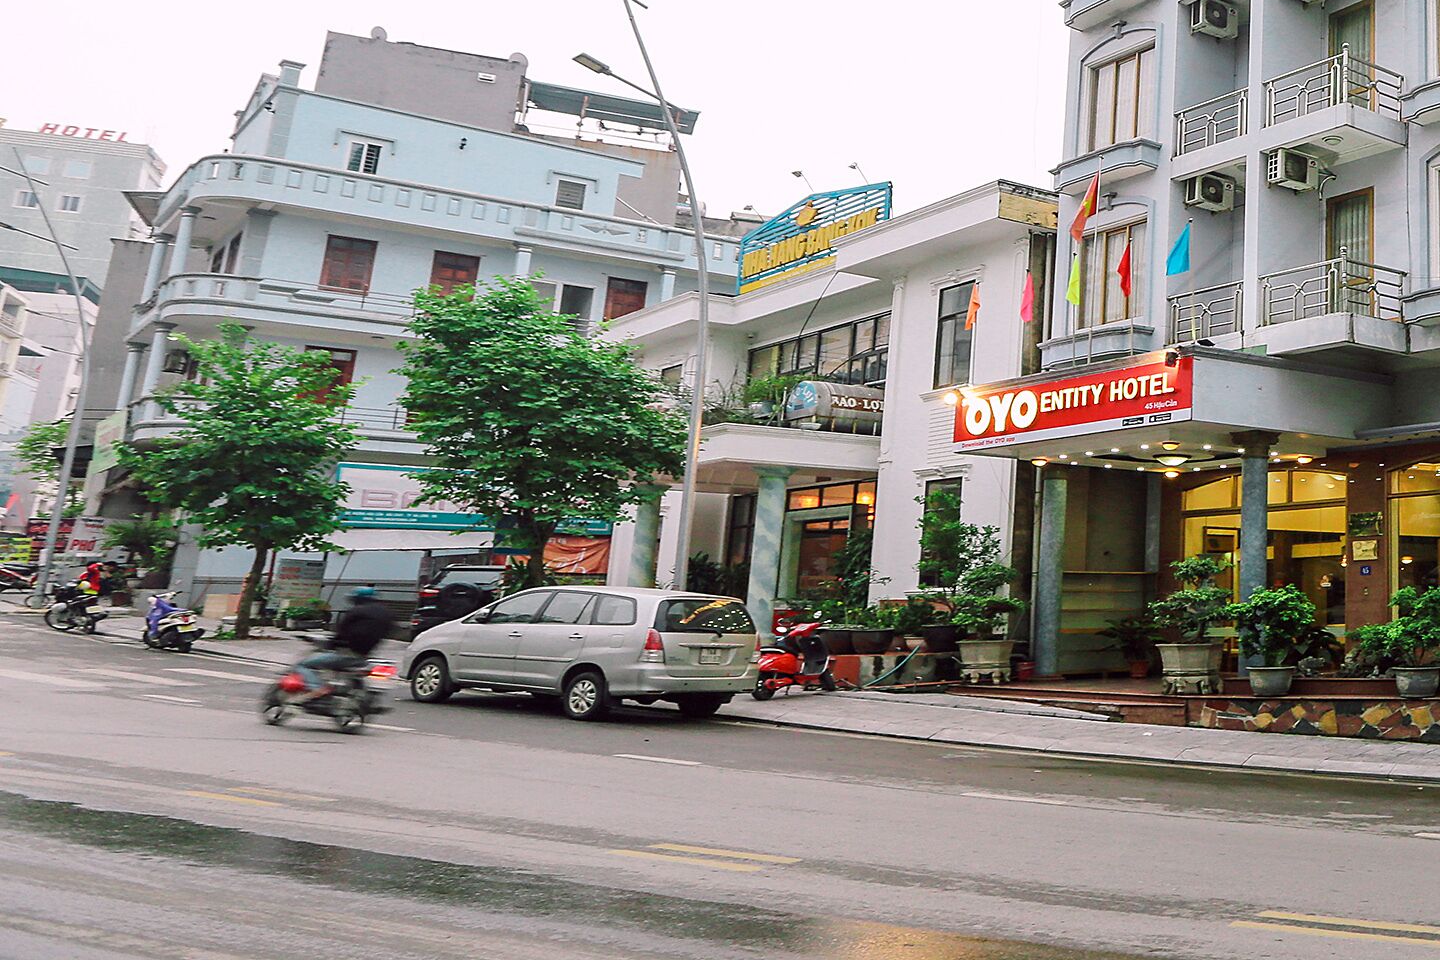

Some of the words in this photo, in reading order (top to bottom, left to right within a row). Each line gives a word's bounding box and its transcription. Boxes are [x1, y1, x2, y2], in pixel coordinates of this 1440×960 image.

[40, 123, 128, 143] HOTEL
[964, 390, 1039, 436] OYO
[1040, 383, 1105, 413] ENTITY
[1109, 372, 1175, 402] HOTEL
